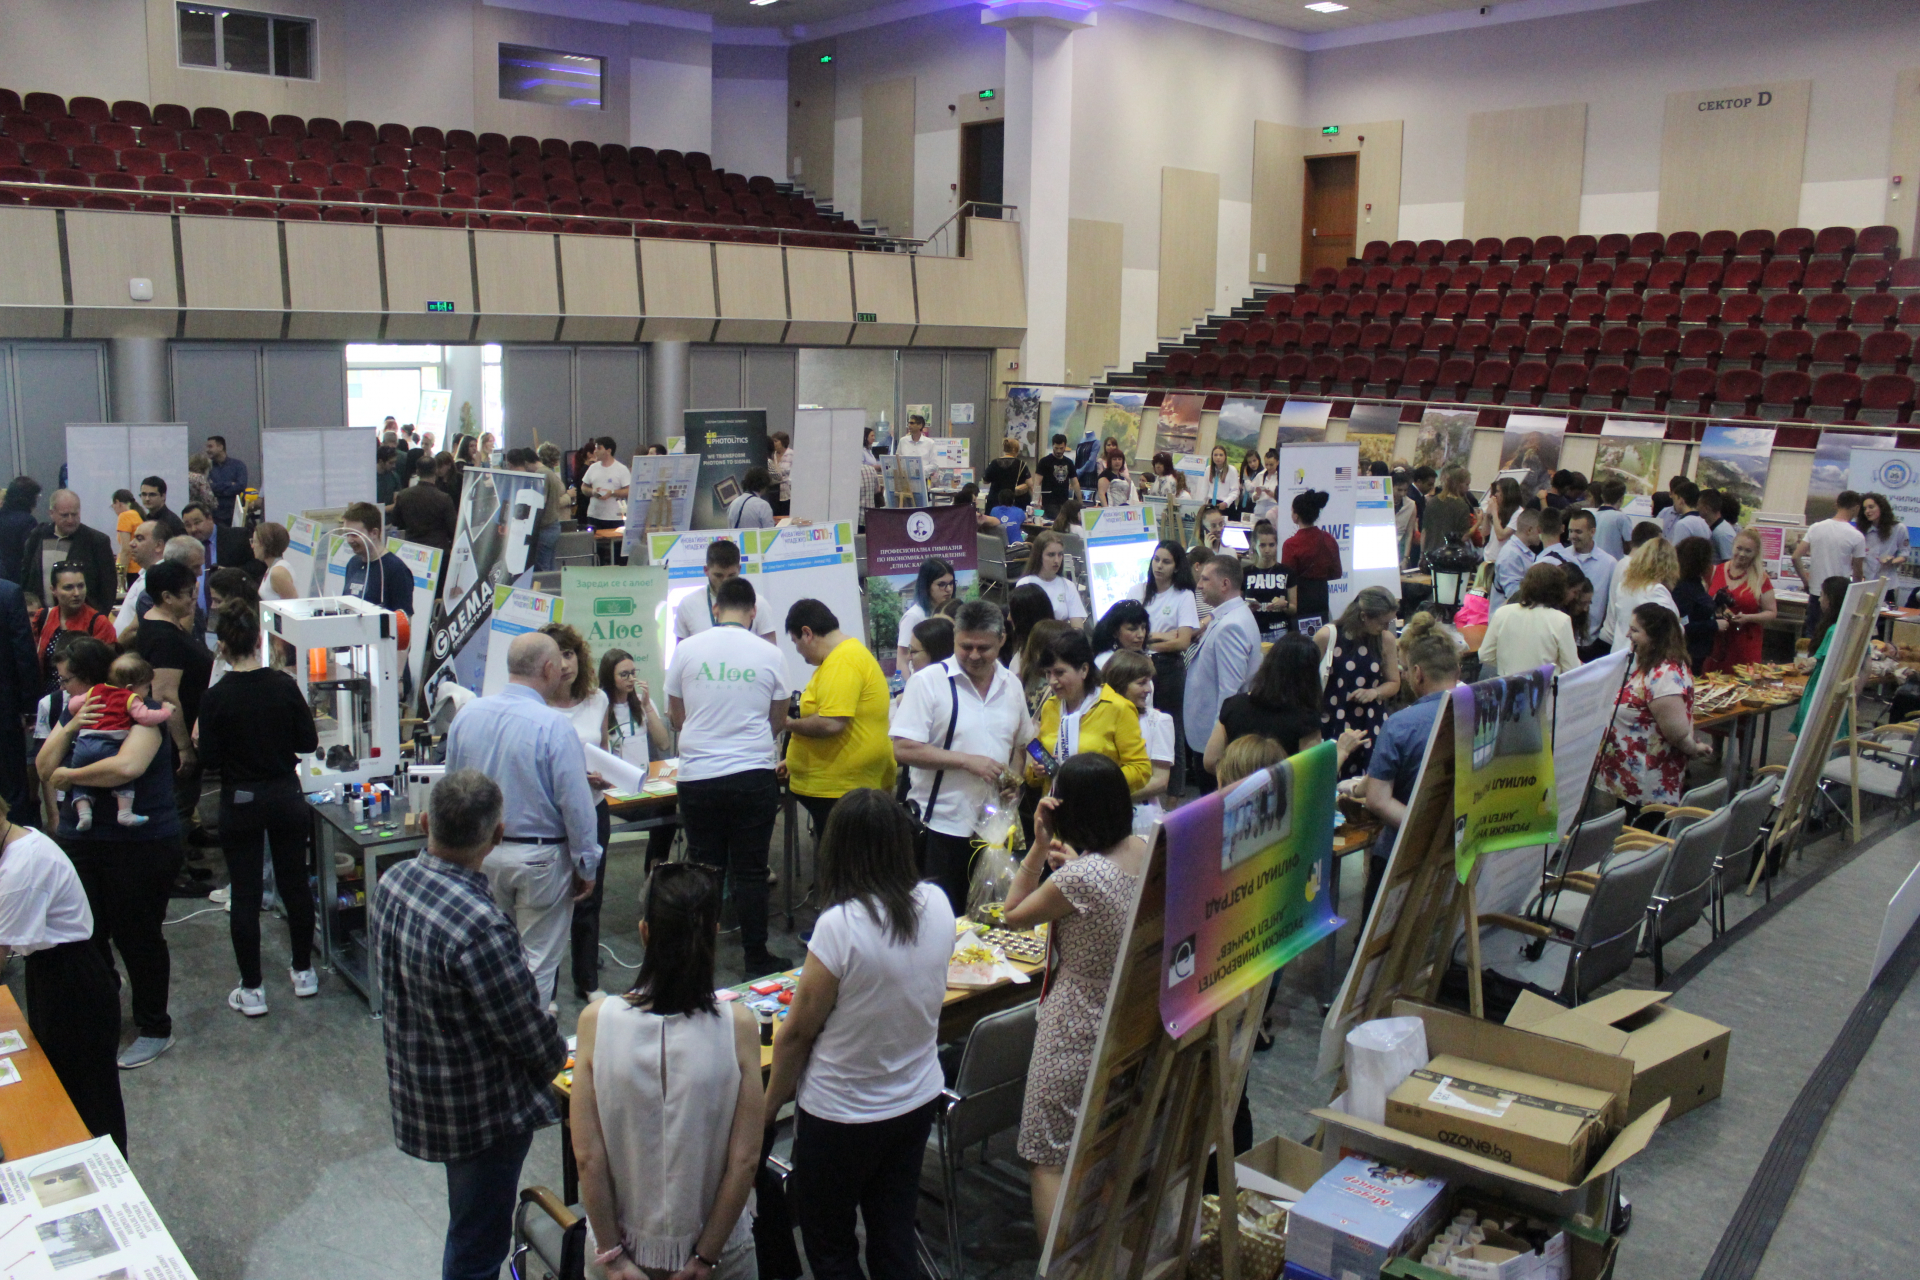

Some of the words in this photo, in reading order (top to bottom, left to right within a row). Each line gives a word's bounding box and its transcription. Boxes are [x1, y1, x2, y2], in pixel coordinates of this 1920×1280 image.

[1697, 97, 1752, 112] СЕКТОР
[1757, 91, 1772, 106] D
[858, 313, 876, 322] EXIT
[880, 547, 931, 555] ПРОФЕСИОНАЛНА
[886, 554, 924, 562] ИКОНОМИКА
[576, 579, 609, 589] Зареди
[629, 578, 653, 587] алое!
[1246, 573, 1288, 590] PAUS
[588, 619, 643, 640] Aloe
[695, 661, 756, 683] Aloe
[1491, 776, 1537, 791] ФИЛИАЛ
[1490, 822, 1531, 837] РУСЕНСКИ
[1256, 853, 1300, 890] ФИЛИАЛ
[1204, 879, 1256, 920] РАЗГРАД
[1262, 916, 1304, 953] РУСЕНСКИ
[1197, 944, 1261, 994] УНИВЕРСИТЕТ
